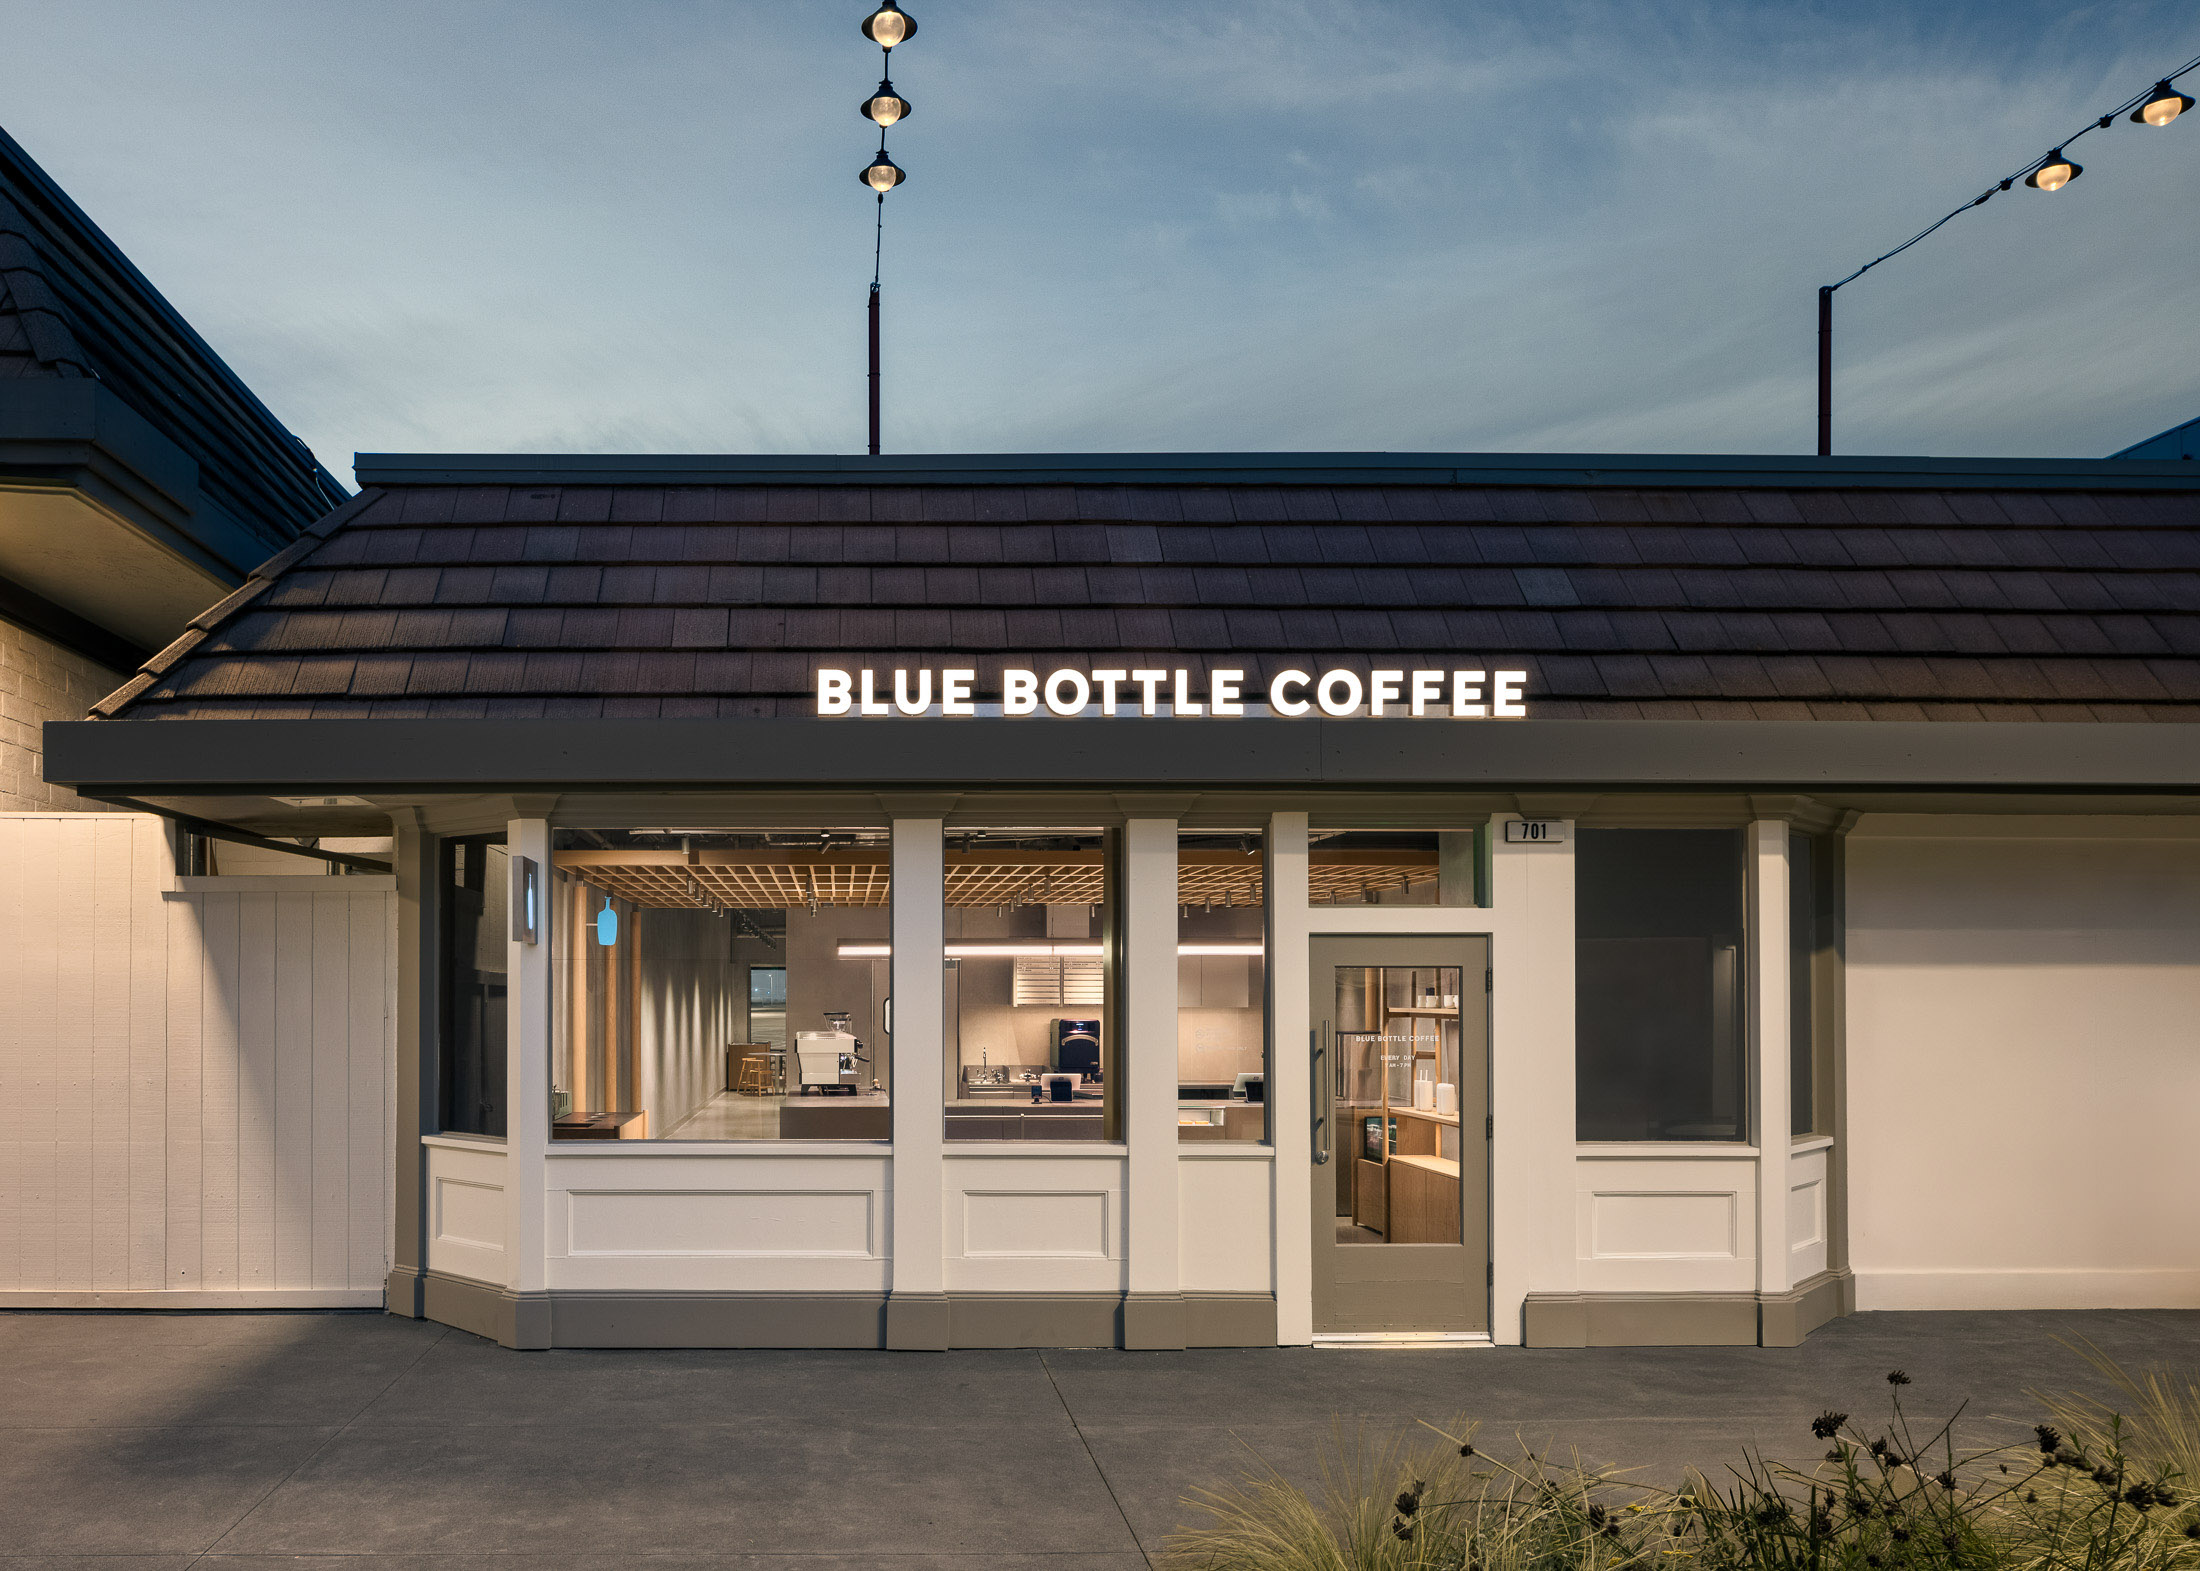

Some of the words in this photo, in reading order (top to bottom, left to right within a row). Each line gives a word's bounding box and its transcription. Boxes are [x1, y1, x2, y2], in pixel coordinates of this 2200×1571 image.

[817, 669, 975, 715] BLUE
[1004, 669, 1244, 715] BOTTLE
[1270, 669, 1527, 717] COFFEE
[1521, 823, 1547, 839] 701
